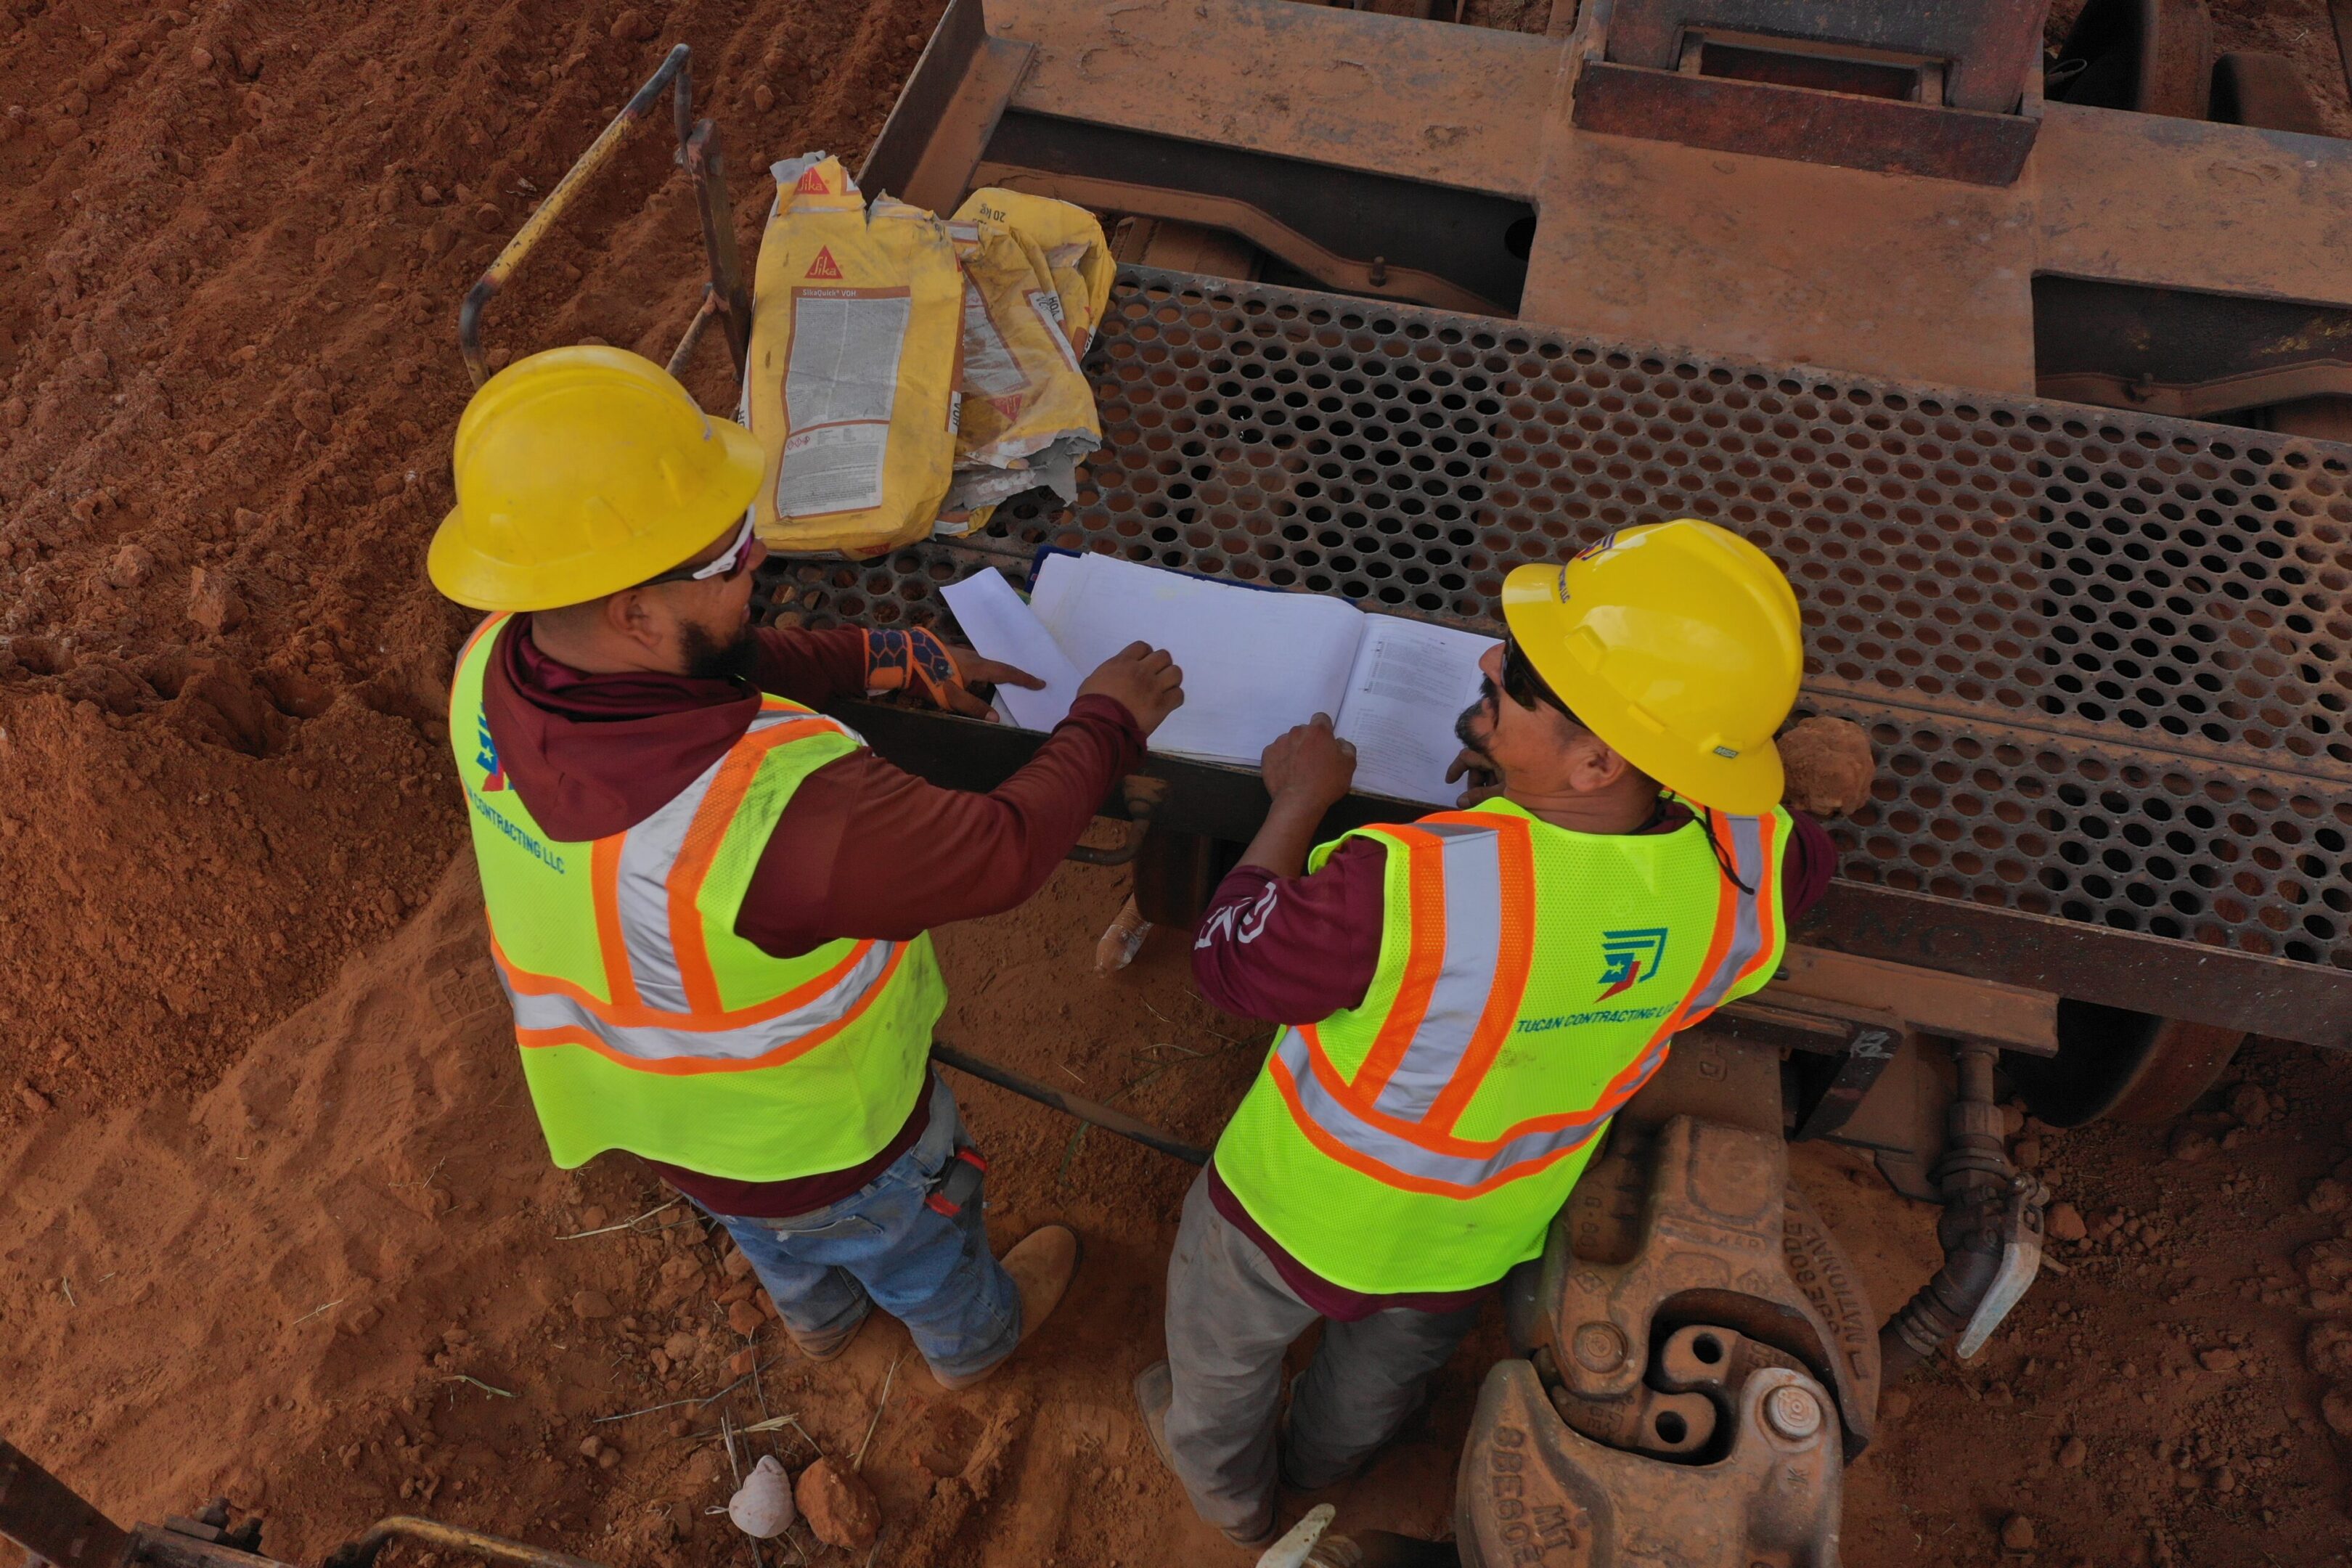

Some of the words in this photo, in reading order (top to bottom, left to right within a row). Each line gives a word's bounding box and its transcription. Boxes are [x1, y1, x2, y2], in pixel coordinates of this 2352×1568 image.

[798, 171, 823, 192] Sika
[979, 203, 992, 219] kg
[993, 209, 1006, 223] 20
[809, 256, 836, 276] Sika
[473, 796, 542, 859] CONTRACTING
[542, 846, 565, 875] LLC
[1516, 1016, 1563, 1034] TUCAN
[1564, 1007, 1658, 1027] CONTRACTING
